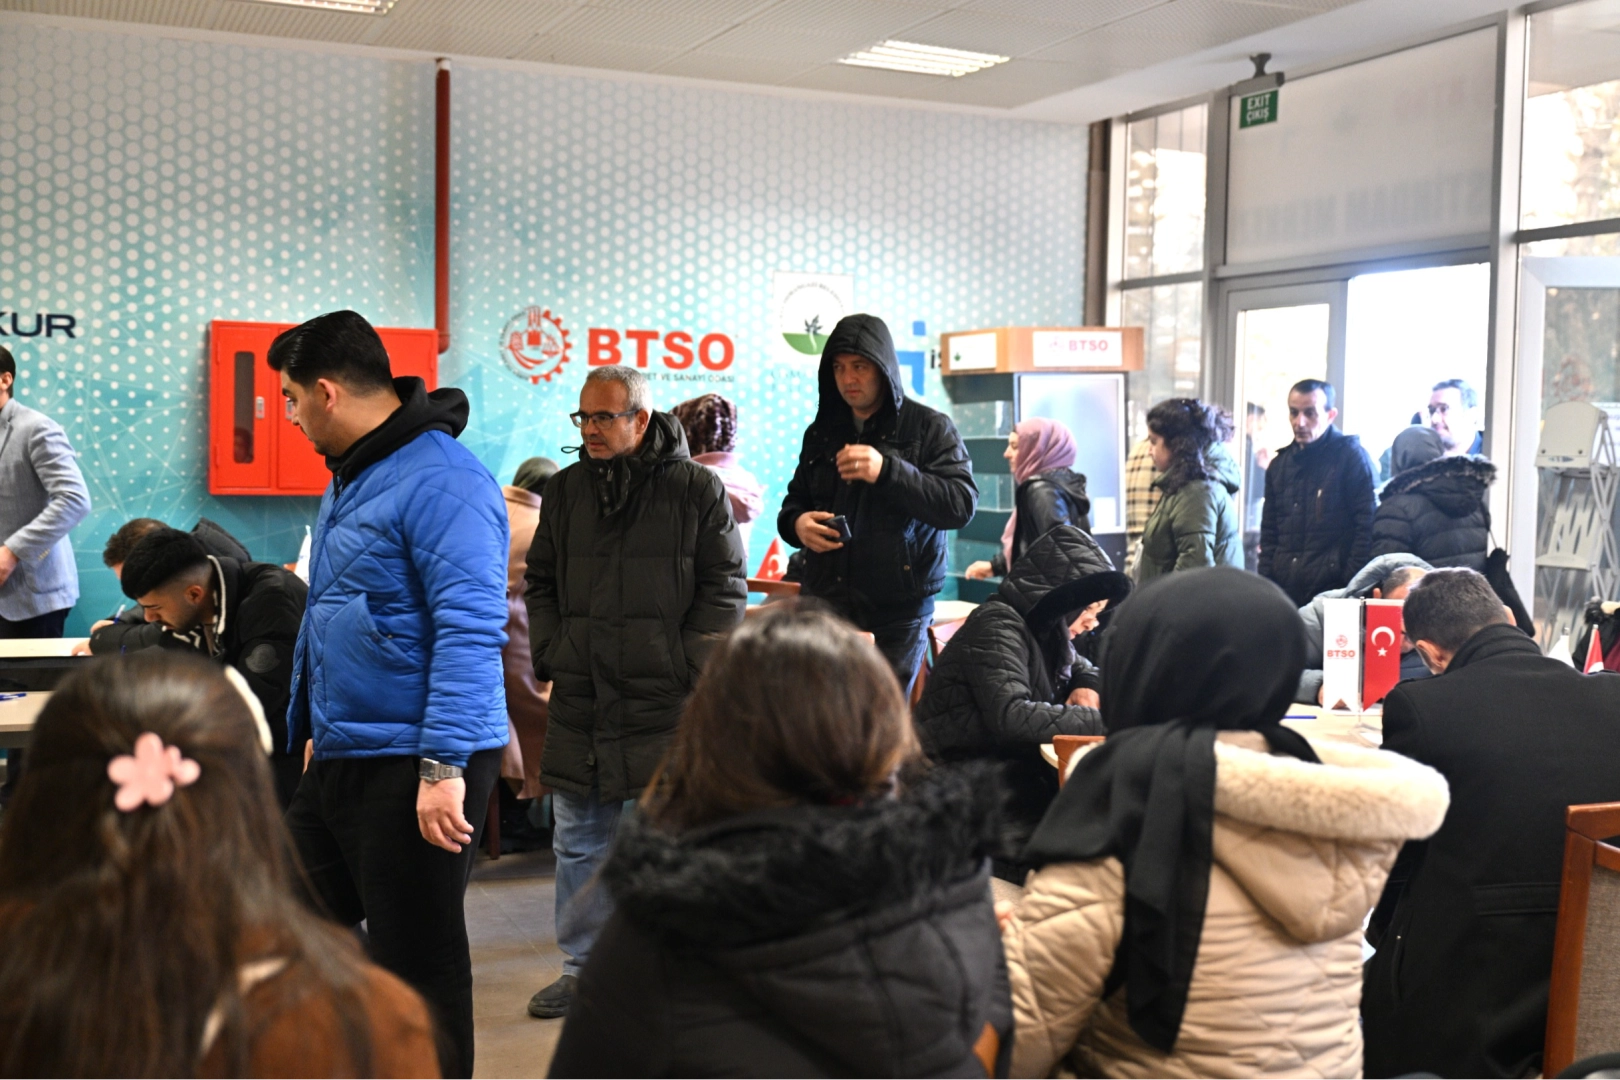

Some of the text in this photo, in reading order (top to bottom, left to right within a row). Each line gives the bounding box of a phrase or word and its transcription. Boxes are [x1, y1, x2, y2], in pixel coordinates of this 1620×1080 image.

[1247, 93, 1271, 110] EXIT
[1246, 107, 1269, 125] ÇIKIŞ
[588, 327, 735, 371] BTSO
[1069, 339, 1109, 352] BTSO
[661, 374, 670, 382] VE
[1326, 649, 1356, 658] BTSO
